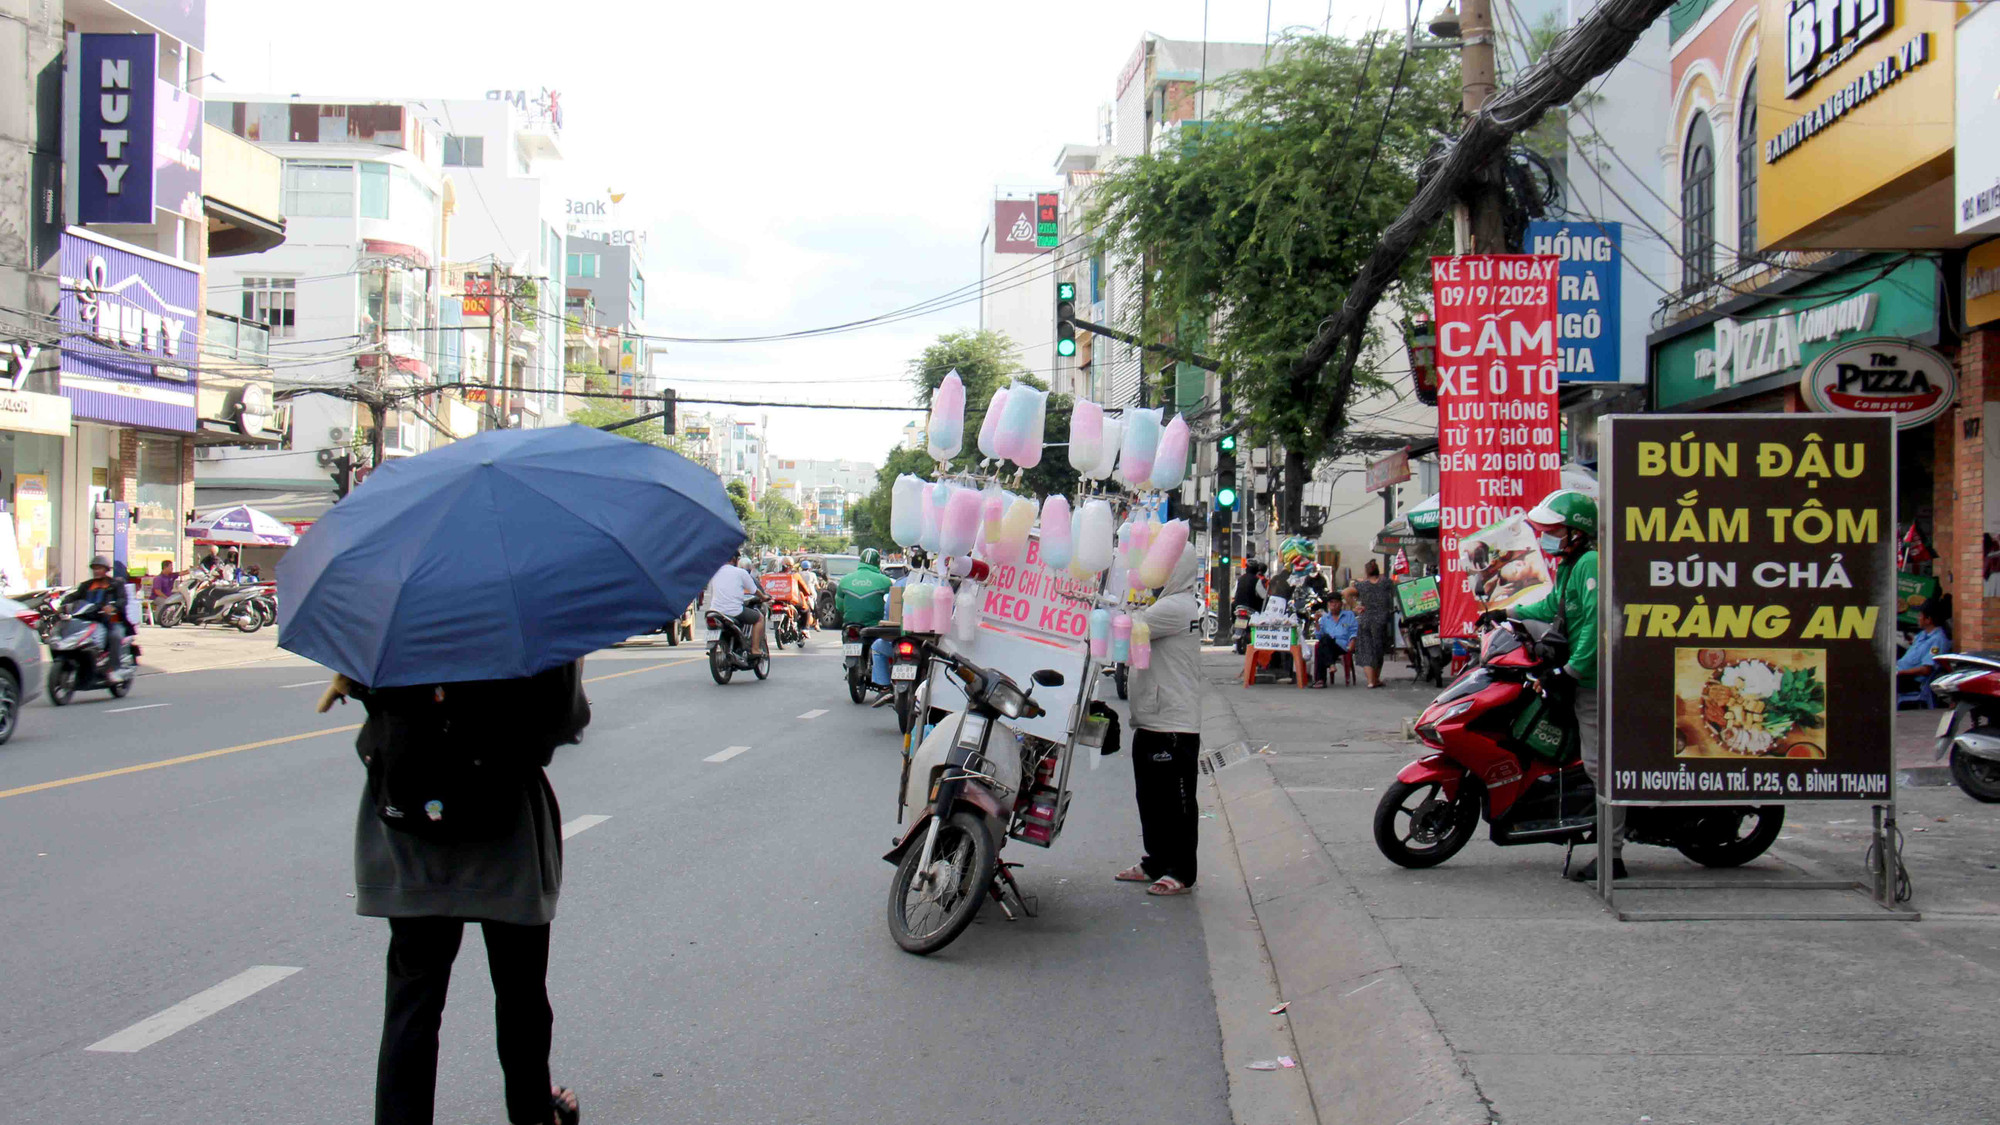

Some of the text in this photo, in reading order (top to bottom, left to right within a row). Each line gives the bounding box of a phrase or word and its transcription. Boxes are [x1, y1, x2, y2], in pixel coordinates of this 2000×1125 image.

[1764, 32, 1929, 164] BANHTRANGGIASI.VN
[98, 58, 132, 194] NUTY
[1434, 256, 1555, 282] KỂ TỪ NGÀY
[96, 299, 185, 356] NUTY
[1440, 309, 1552, 357] CẤM
[1714, 308, 1801, 390] PIZZA
[1798, 293, 1878, 343] Company
[1437, 359, 1559, 396] XE Ô TÔ
[1837, 363, 1931, 393] PIZZA
[1870, 353, 1898, 368] The
[1448, 399, 1548, 420] LƯU THÔNG
[1854, 399, 1914, 411] Company
[1444, 423, 1553, 446] TỪ 17 GIỜ 00
[1440, 449, 1560, 471] ĐẾN 20 GIỜ 00
[1638, 431, 1865, 488] BÚN ĐẬU
[1477, 475, 1523, 497] TRÊN
[1626, 489, 1878, 543] MẮM TÔM
[852, 577, 872, 587] Grab
[1650, 553, 1852, 588] BÚN CHẢ
[983, 590, 1030, 622] KẸO
[1039, 605, 1087, 636] KÉO
[1623, 595, 1880, 639] TRÀNG AN
[1615, 771, 1637, 790] 191
[1642, 764, 1695, 791] NGUYỄN
[1699, 773, 1723, 792] GIA
[1787, 774, 1802, 793] Q.
[1806, 768, 1838, 792] BÌNH
[1841, 774, 1887, 798] THẠNH
